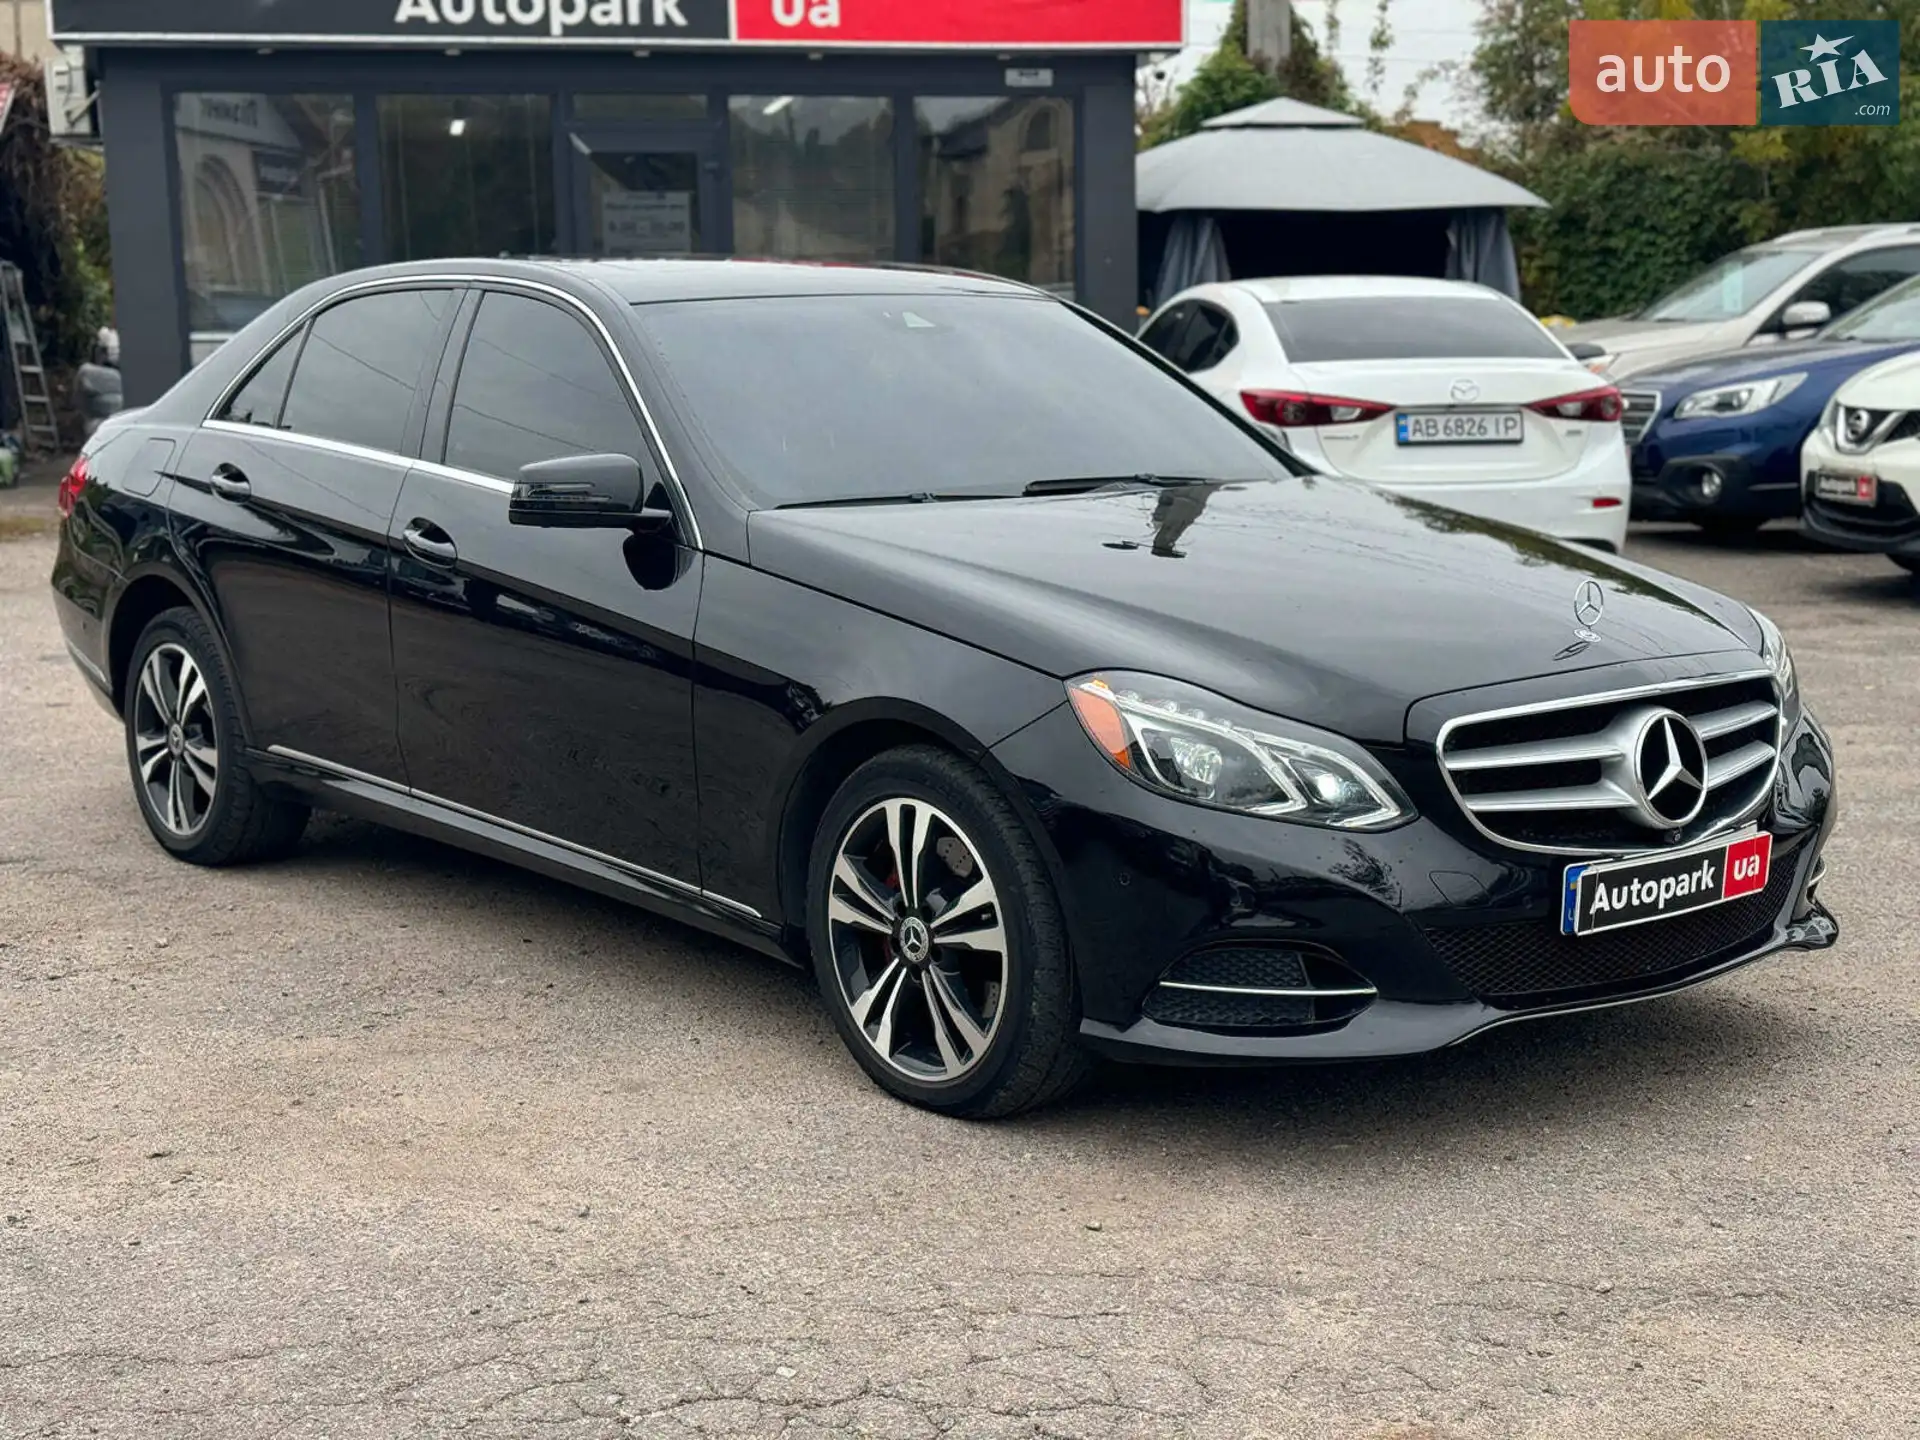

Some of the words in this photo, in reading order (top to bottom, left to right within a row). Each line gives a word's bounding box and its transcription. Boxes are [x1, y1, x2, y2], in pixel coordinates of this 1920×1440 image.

[394, 0, 688, 36] Autopark
[1412, 417, 1439, 437] AB
[1443, 416, 1488, 436] 6826
[1589, 859, 1716, 914] Autopark
[1732, 853, 1760, 881] ua
